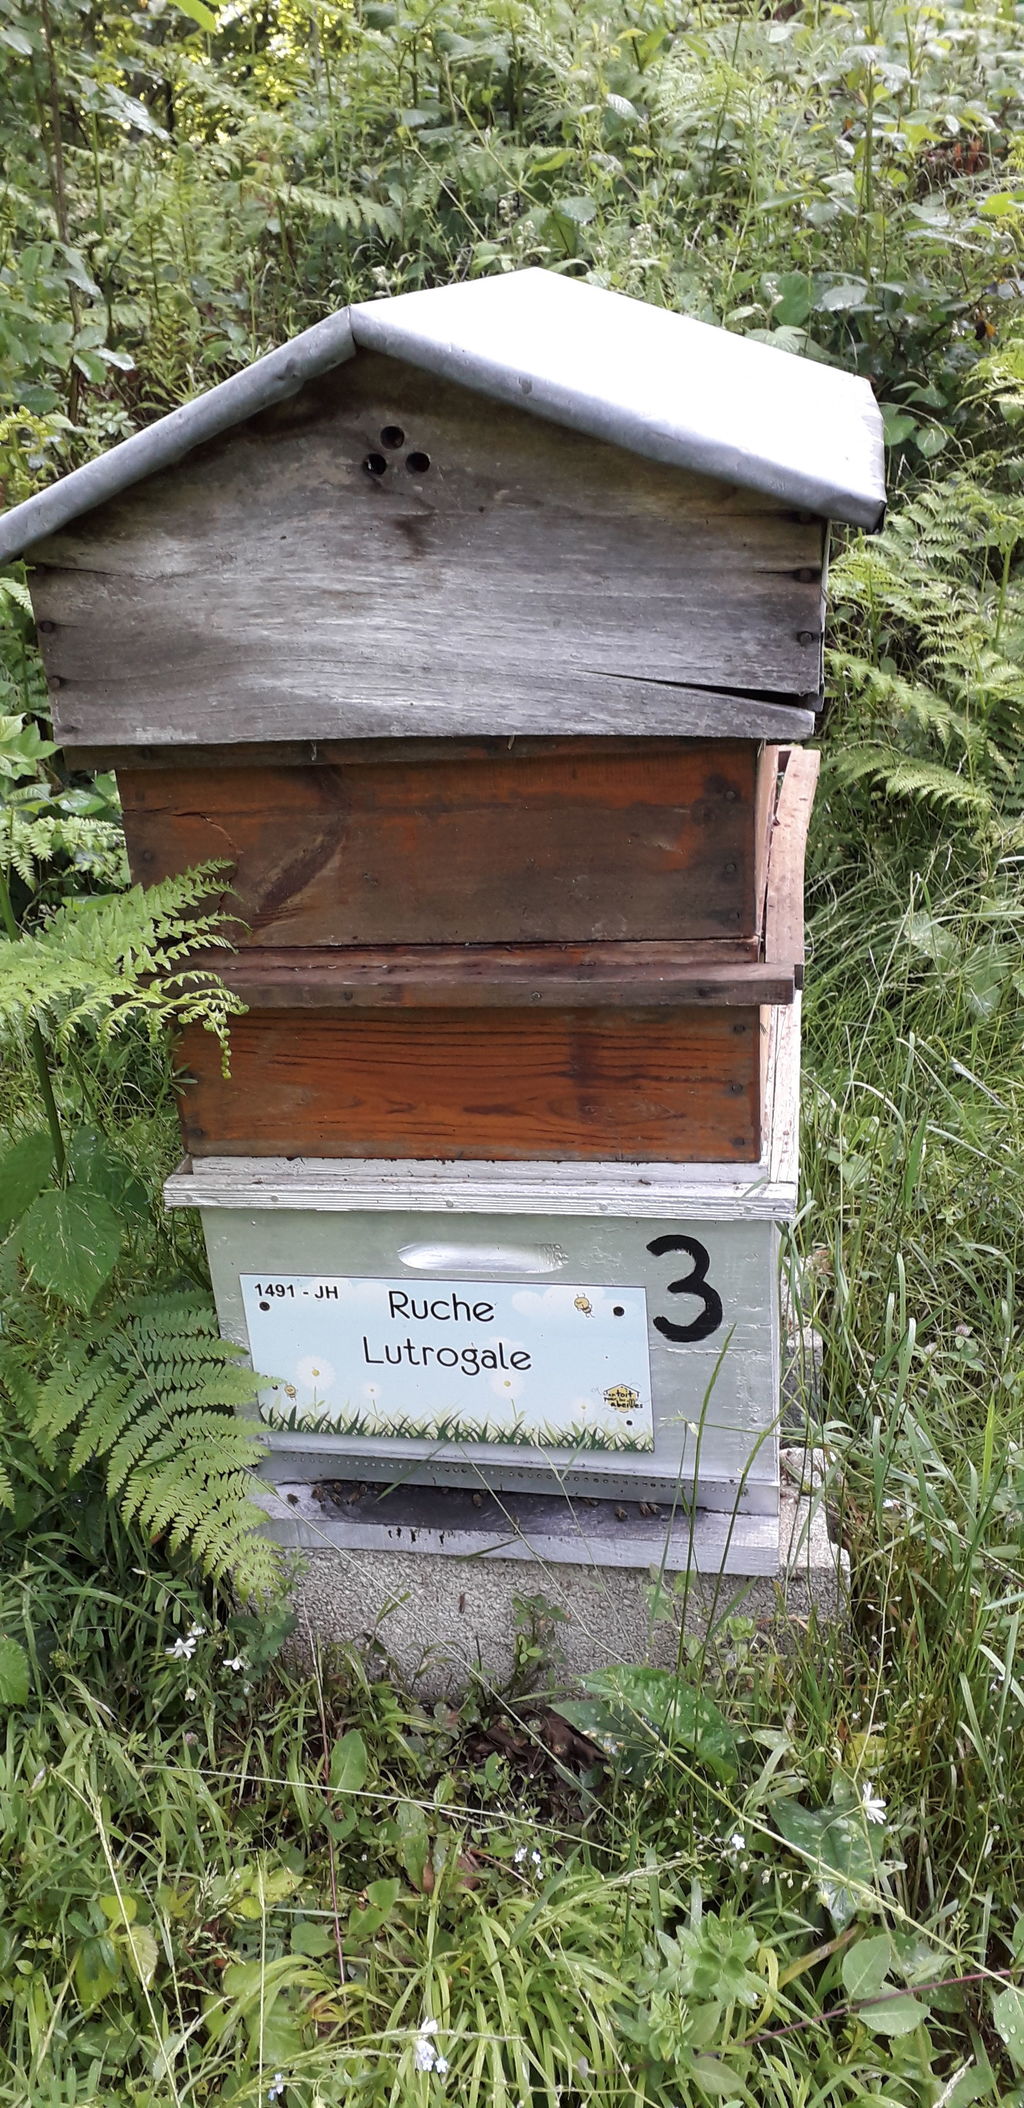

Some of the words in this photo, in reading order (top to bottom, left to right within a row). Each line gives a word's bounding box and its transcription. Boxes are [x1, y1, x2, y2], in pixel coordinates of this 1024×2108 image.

[254, 1283, 295, 1298] 1491
[314, 1285, 339, 1300] JH
[388, 1290, 495, 1322] Ruche
[646, 1234, 723, 1343] 3
[363, 1336, 532, 1375] Lutrogale
